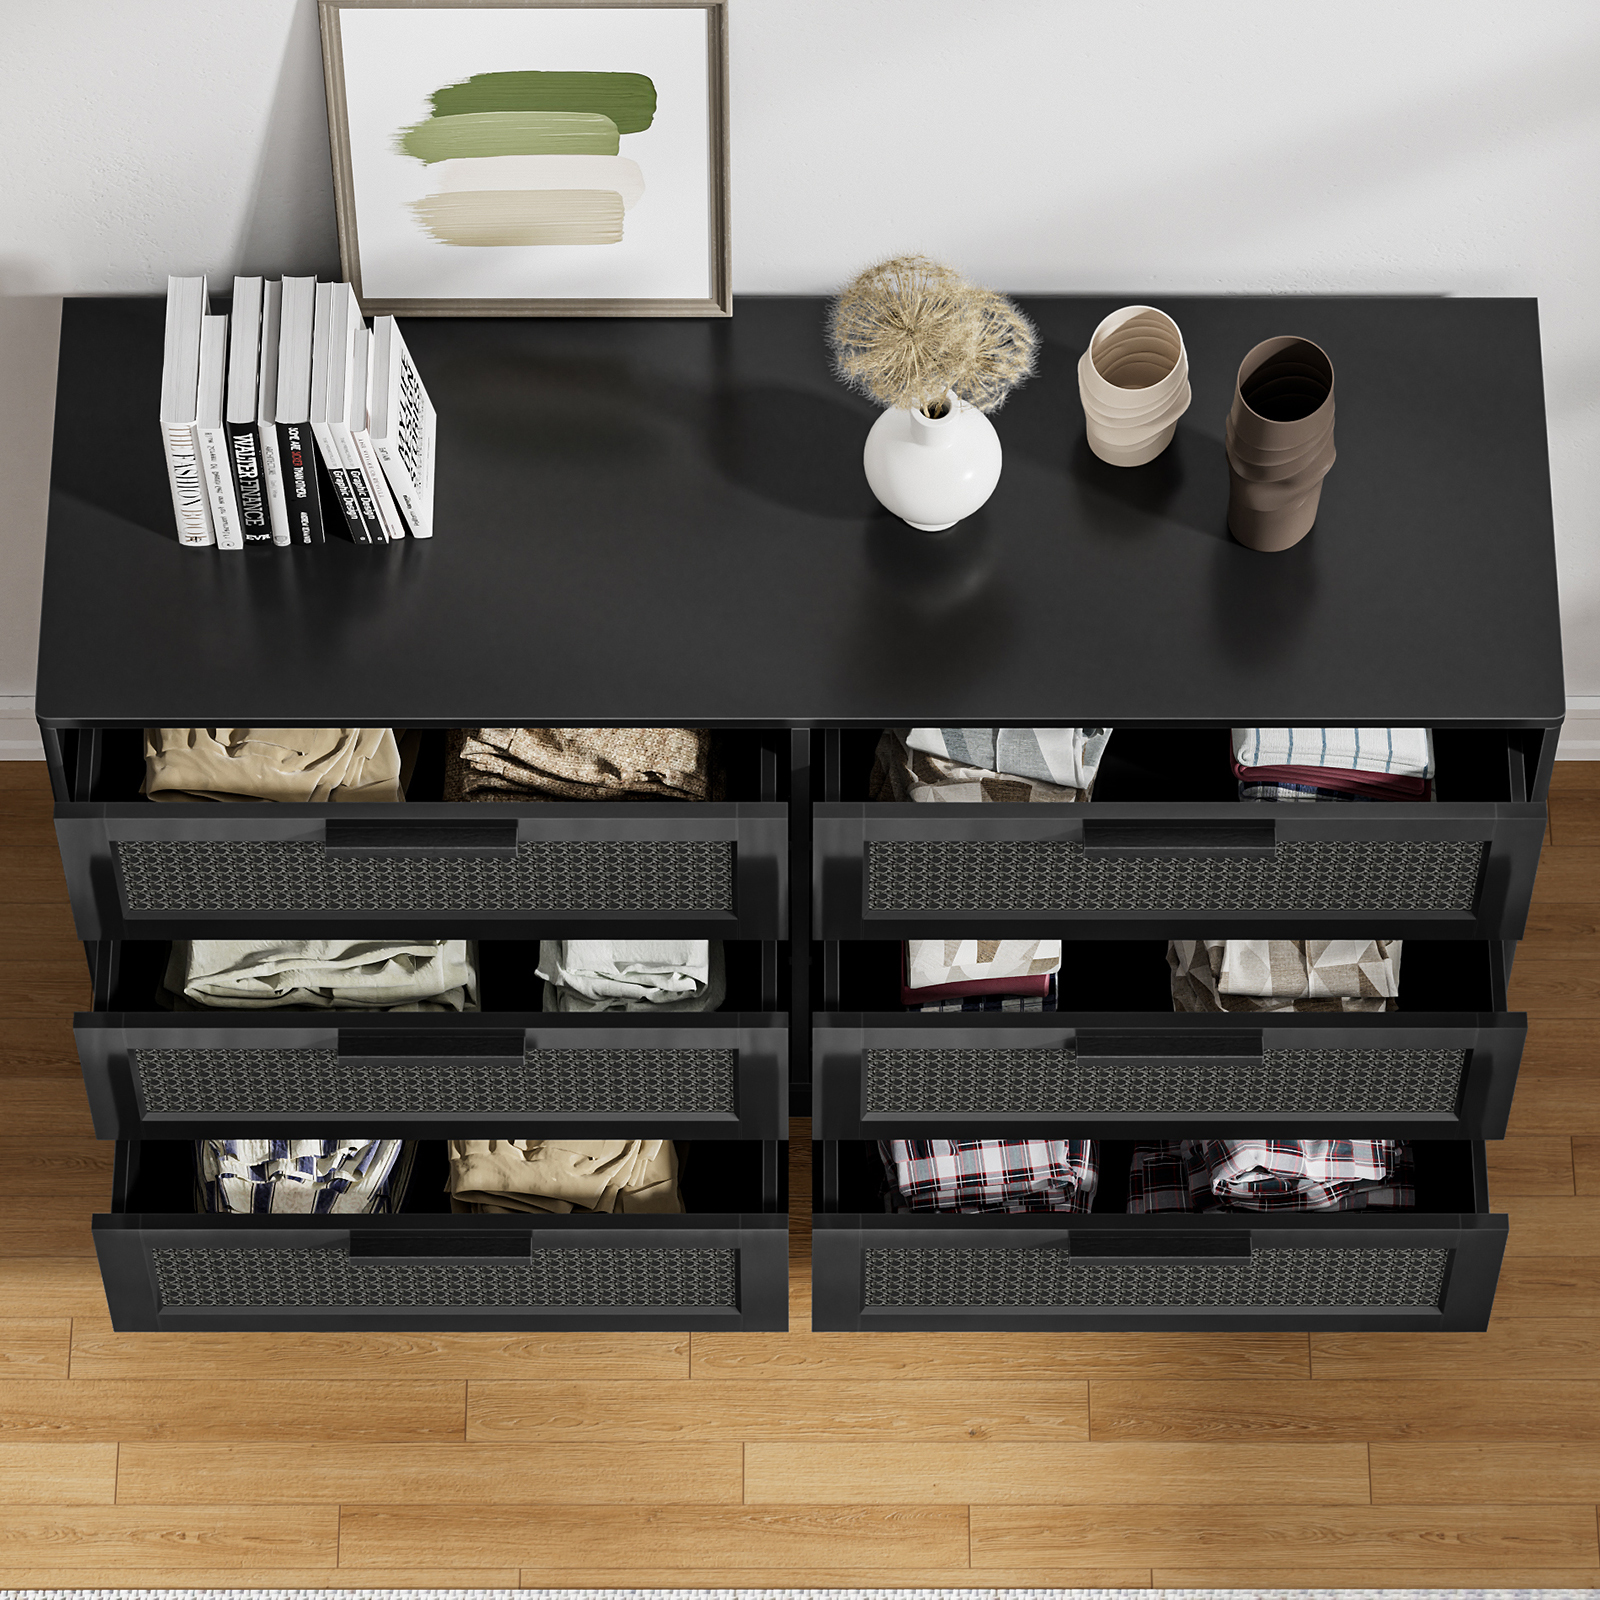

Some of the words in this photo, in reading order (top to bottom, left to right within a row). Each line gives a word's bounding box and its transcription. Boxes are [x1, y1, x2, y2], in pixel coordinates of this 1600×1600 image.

[168, 425, 195, 451] THE
[288, 427, 300, 441] SOME
[403, 362, 413, 475] DESIGN
[232, 433, 258, 479] WALTER
[290, 440, 302, 451] ARE
[172, 454, 203, 506] FASHION
[293, 466, 304, 481] THAN
[295, 480, 307, 498] OTHERS
[239, 478, 265, 526] FINANCE
[333, 470, 351, 496] Graphic
[343, 497, 358, 520] Design
[350, 470, 369, 496] Graphic
[361, 497, 376, 520] Design
[180, 508, 207, 542] BOOK
